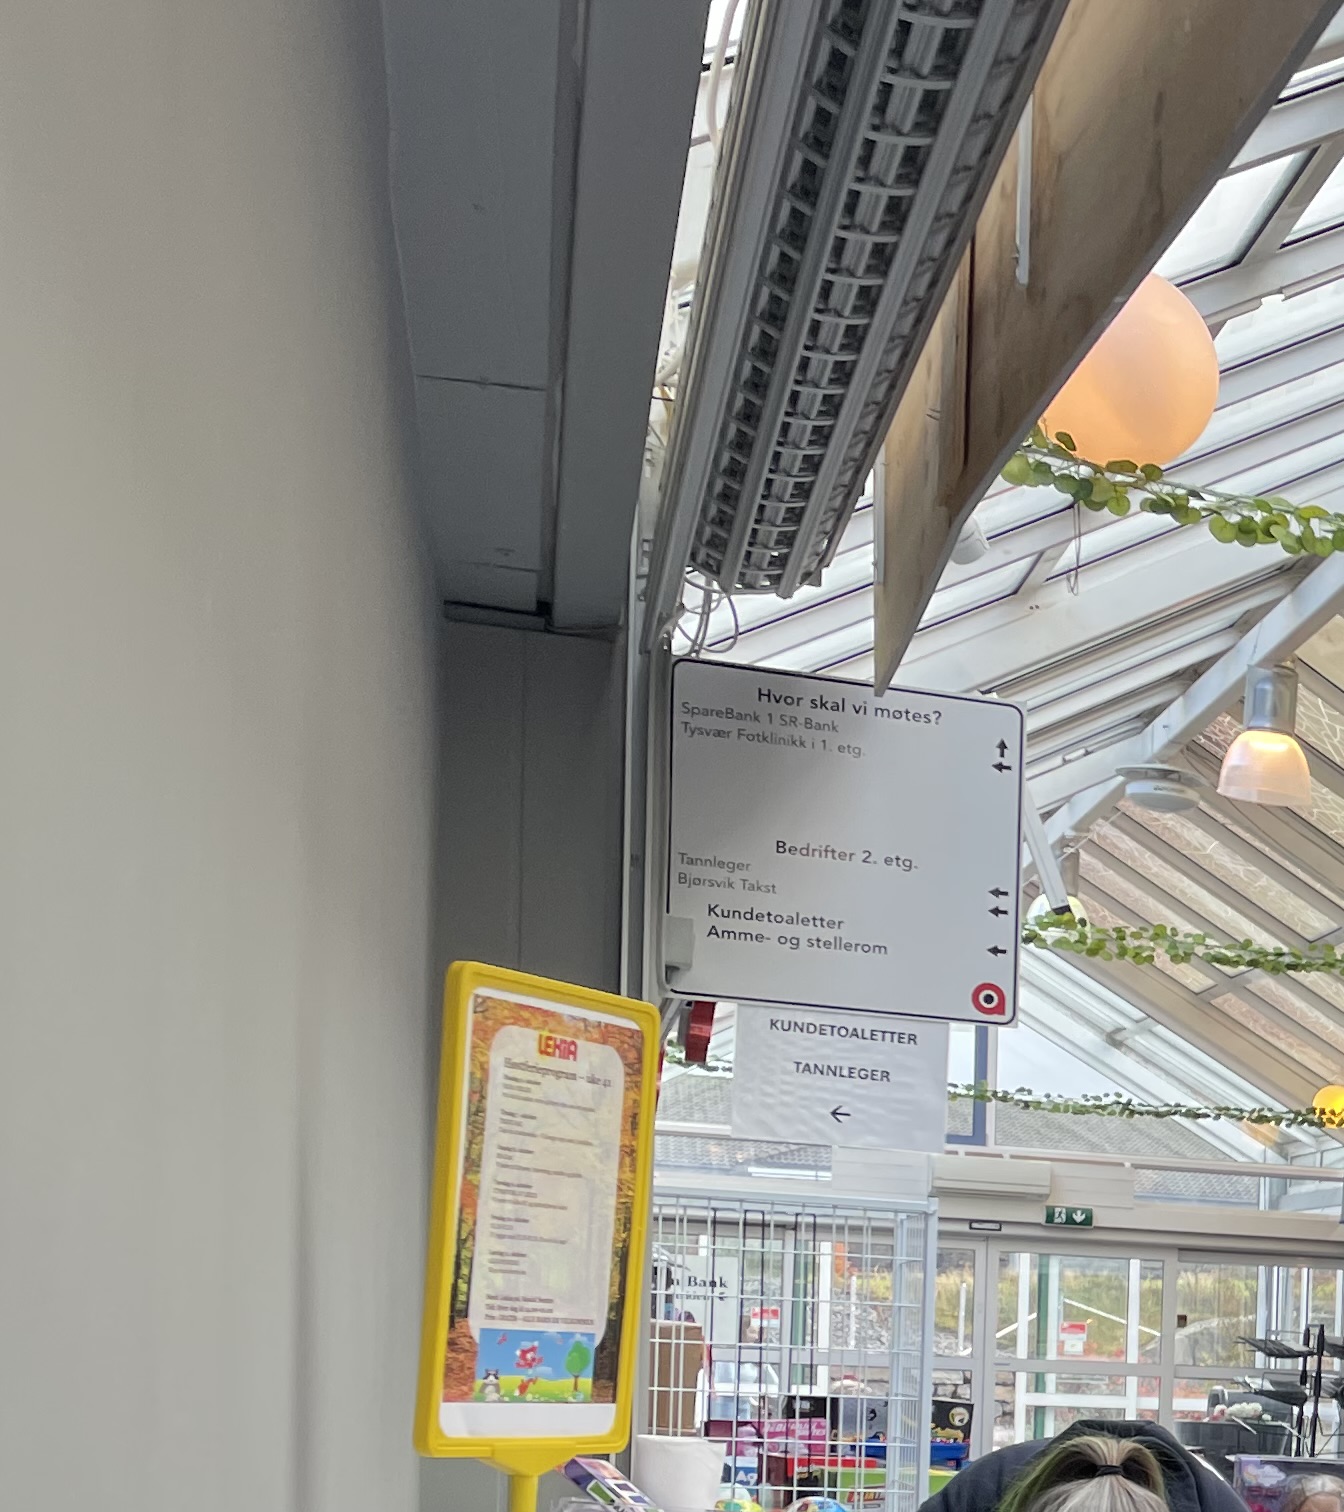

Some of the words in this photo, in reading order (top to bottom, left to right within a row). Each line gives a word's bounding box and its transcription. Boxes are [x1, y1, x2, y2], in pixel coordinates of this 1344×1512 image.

[681, 701, 761, 725] SpareBank
[767, 713, 774, 725] 1
[779, 714, 839, 733] SR-Bank
[757, 687, 803, 707] Hvor
[810, 695, 845, 713] skal
[852, 702, 868, 716] vi
[874, 706, 942, 726] møtes?
[681, 721, 732, 741] Tysvær
[737, 728, 806, 749] Fotklinikk
[811, 738, 816, 750] i
[837, 743, 867, 759] etg.
[678, 852, 751, 874] Tannleger
[775, 840, 856, 862] Bedrifter
[861, 850, 878, 865] 2.
[883, 853, 919, 873] etg.
[741, 878, 777, 895] Takst
[707, 904, 845, 930] Kundetoaletter
[706, 925, 771, 944] Amme-
[777, 934, 800, 950] og
[806, 935, 888, 955] stellerom
[769, 1018, 918, 1046] KUNDETOALETTER
[793, 1061, 891, 1083] TANNLEGER
